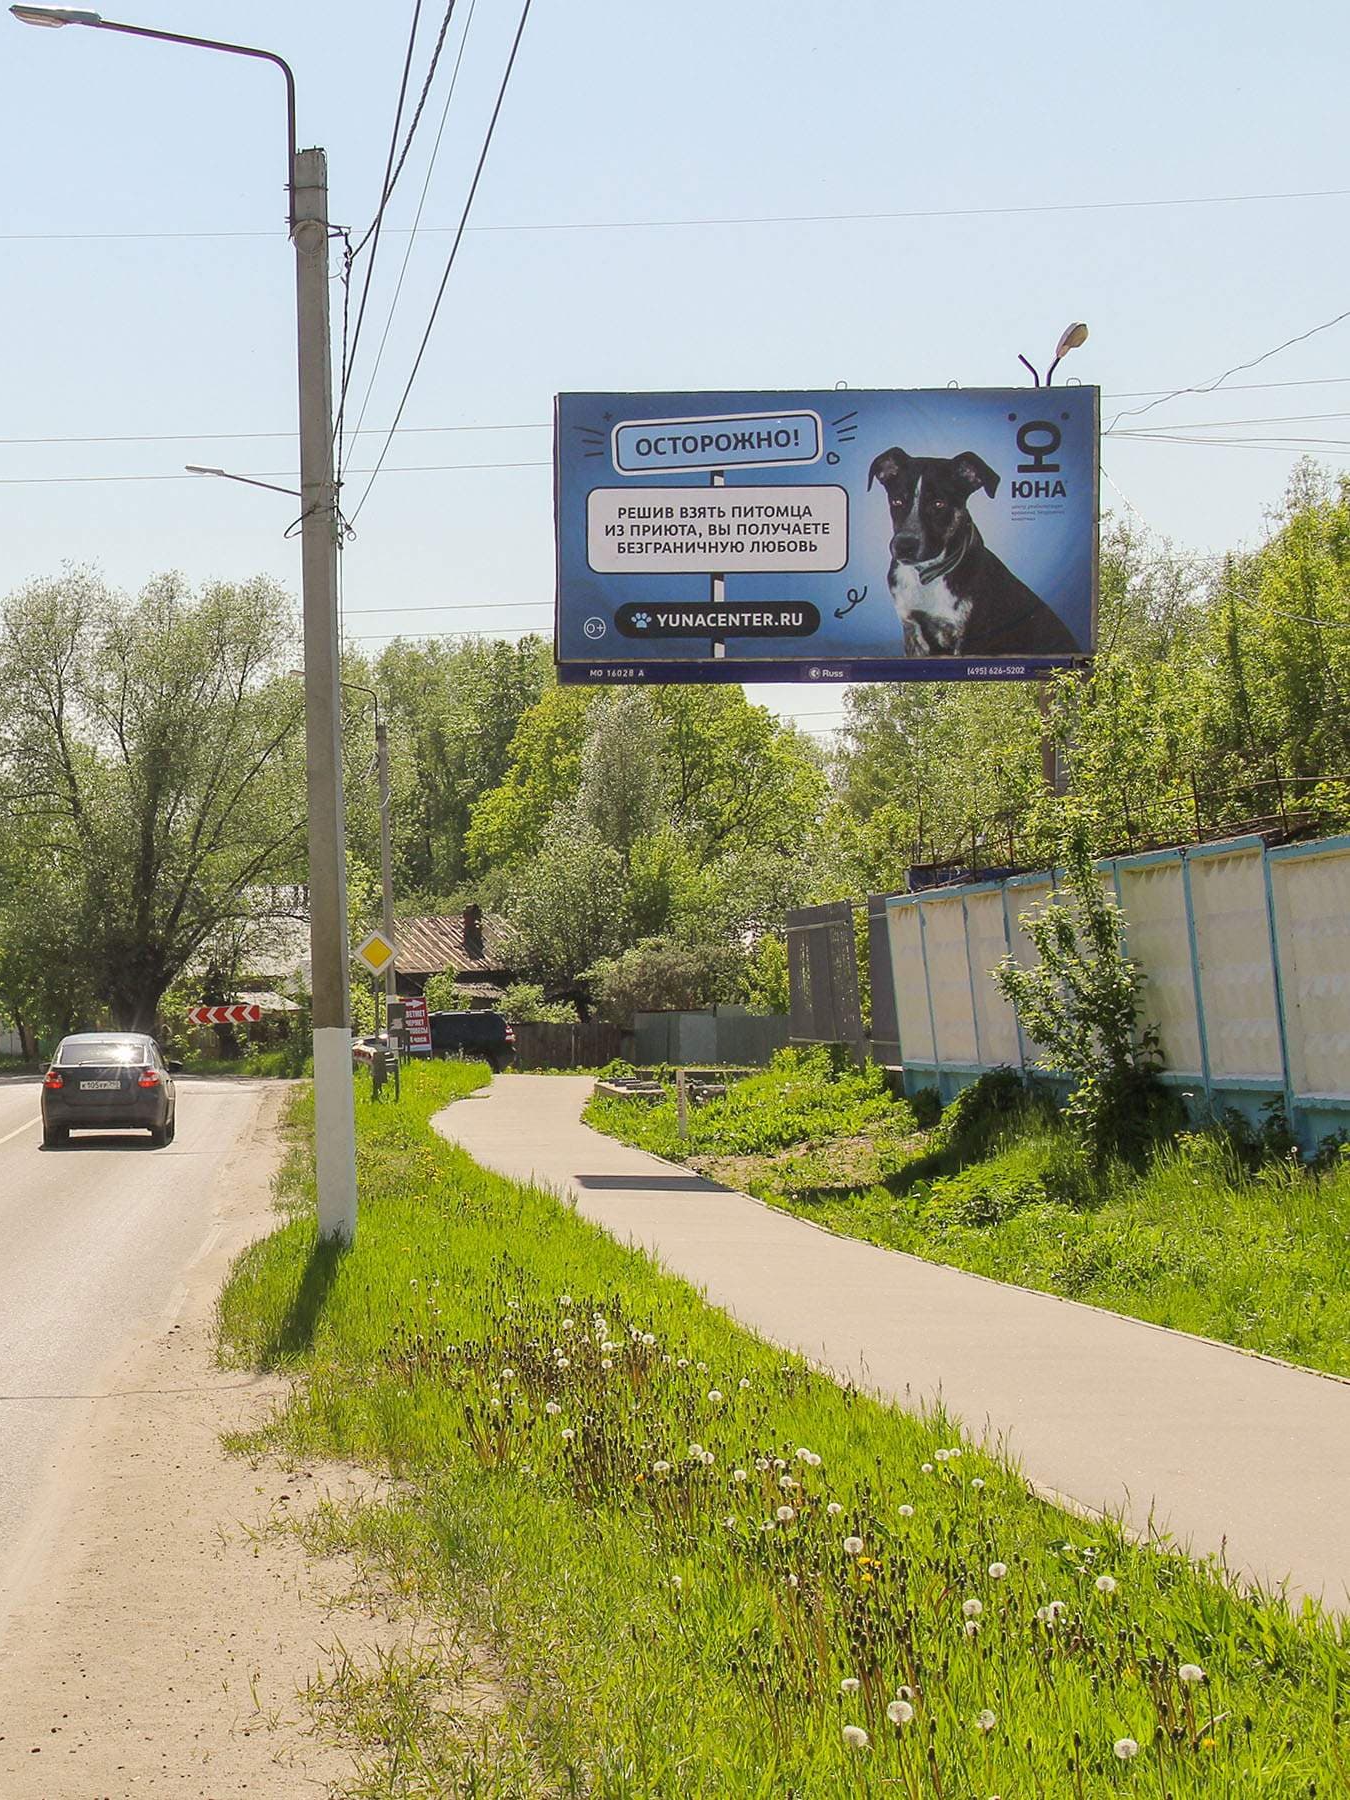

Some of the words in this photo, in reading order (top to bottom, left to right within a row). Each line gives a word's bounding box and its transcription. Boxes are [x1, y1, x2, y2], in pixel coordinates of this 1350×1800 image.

[635, 428, 800, 457] ОСТОРОЖНО!
[1011, 480, 1067, 499] ЮНА
[617, 506, 675, 520] РЕШИВ
[679, 505, 727, 519] ВЗЯТЬ
[731, 504, 813, 519] ПИТОМЦА
[604, 524, 625, 537] ИЗ
[630, 523, 703, 538] ПРИЮТА,
[707, 523, 731, 536] ВЫ
[736, 522, 831, 536] ПОЛУЧАЕТЕ
[617, 541, 745, 555] БЕЗГРАНИЧНУЮ
[749, 540, 818, 553] ЛЮБОВЬ
[656, 612, 803, 627] YUNACENTER.RU
[821, 669, 844, 679] Russ
[988, 666, 1026, 675] 626-5202
